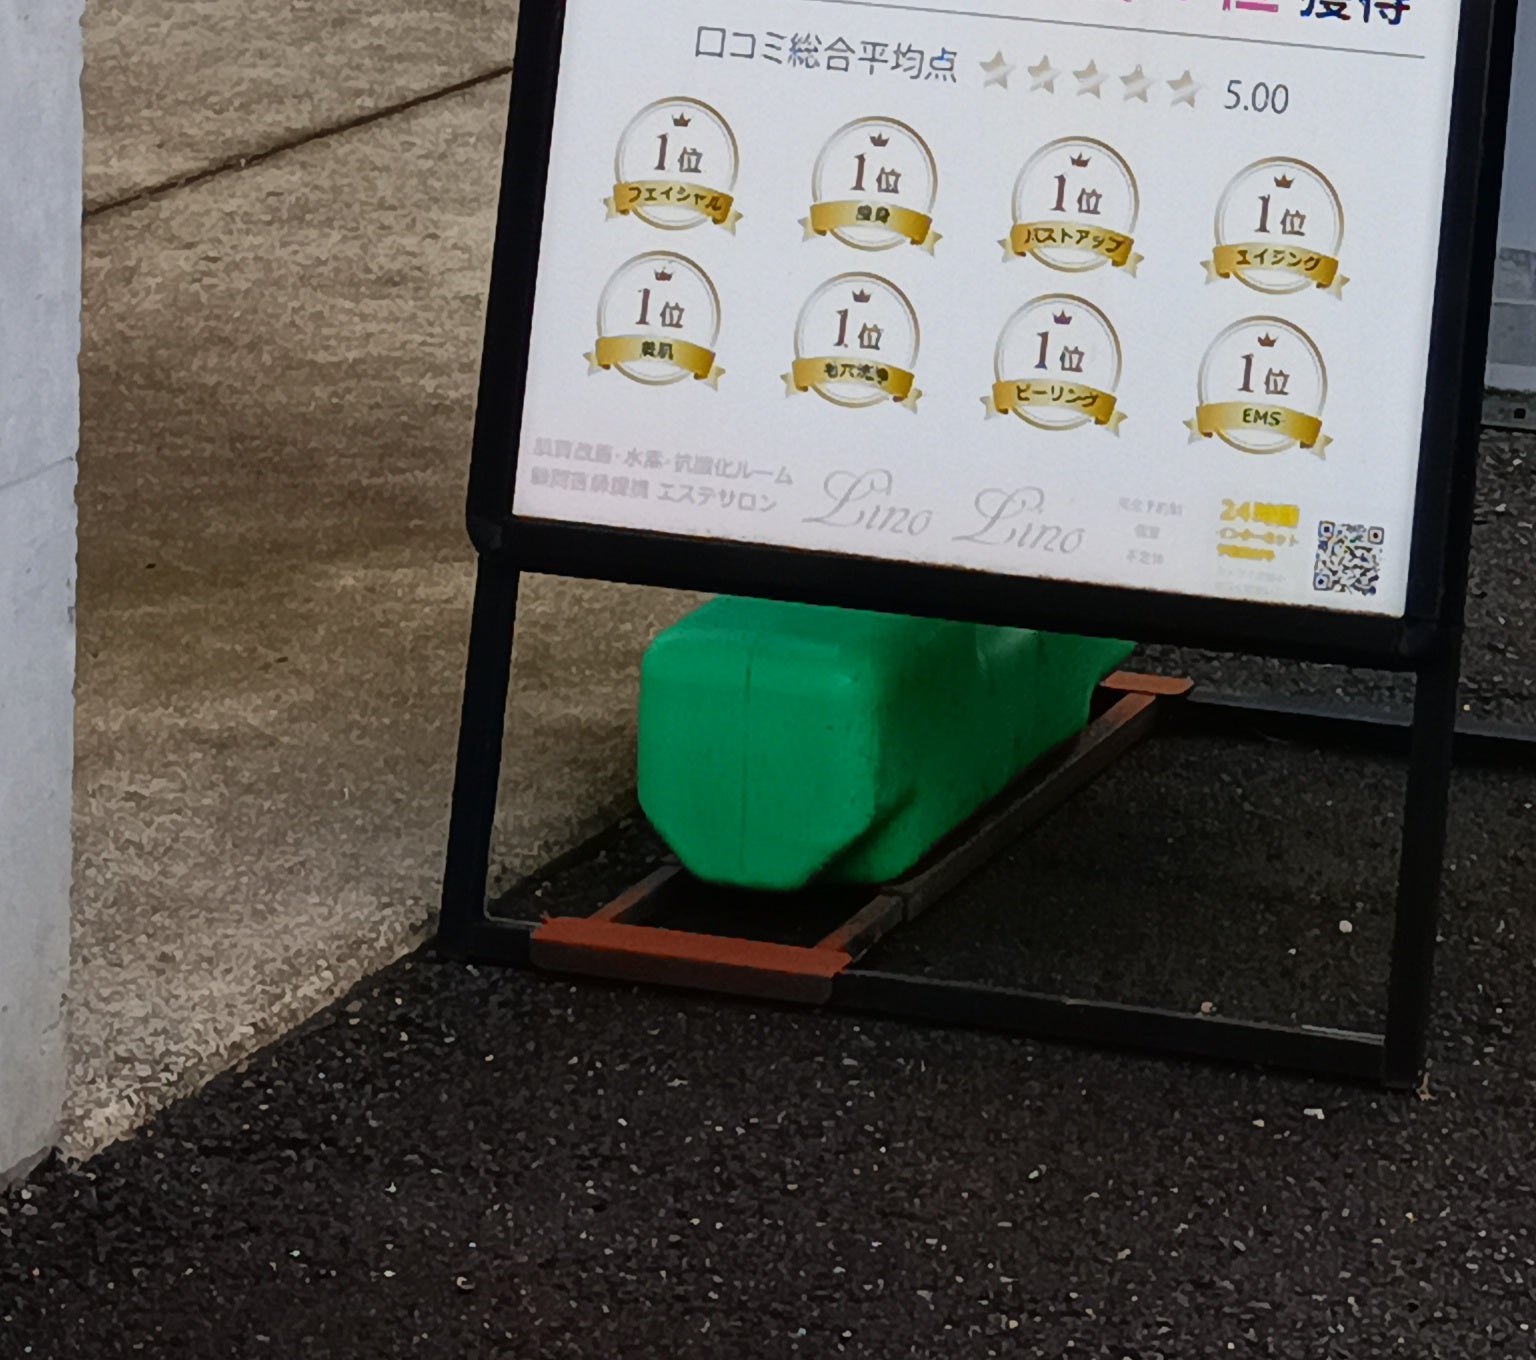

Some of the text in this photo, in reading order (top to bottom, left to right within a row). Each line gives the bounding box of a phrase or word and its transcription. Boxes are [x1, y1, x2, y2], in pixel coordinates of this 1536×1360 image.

[695, 26, 1289, 114] 口コミ総合平均点 5.00
[1242, 408, 1283, 426] EMS
[801, 468, 1086, 553] Lino Lino
